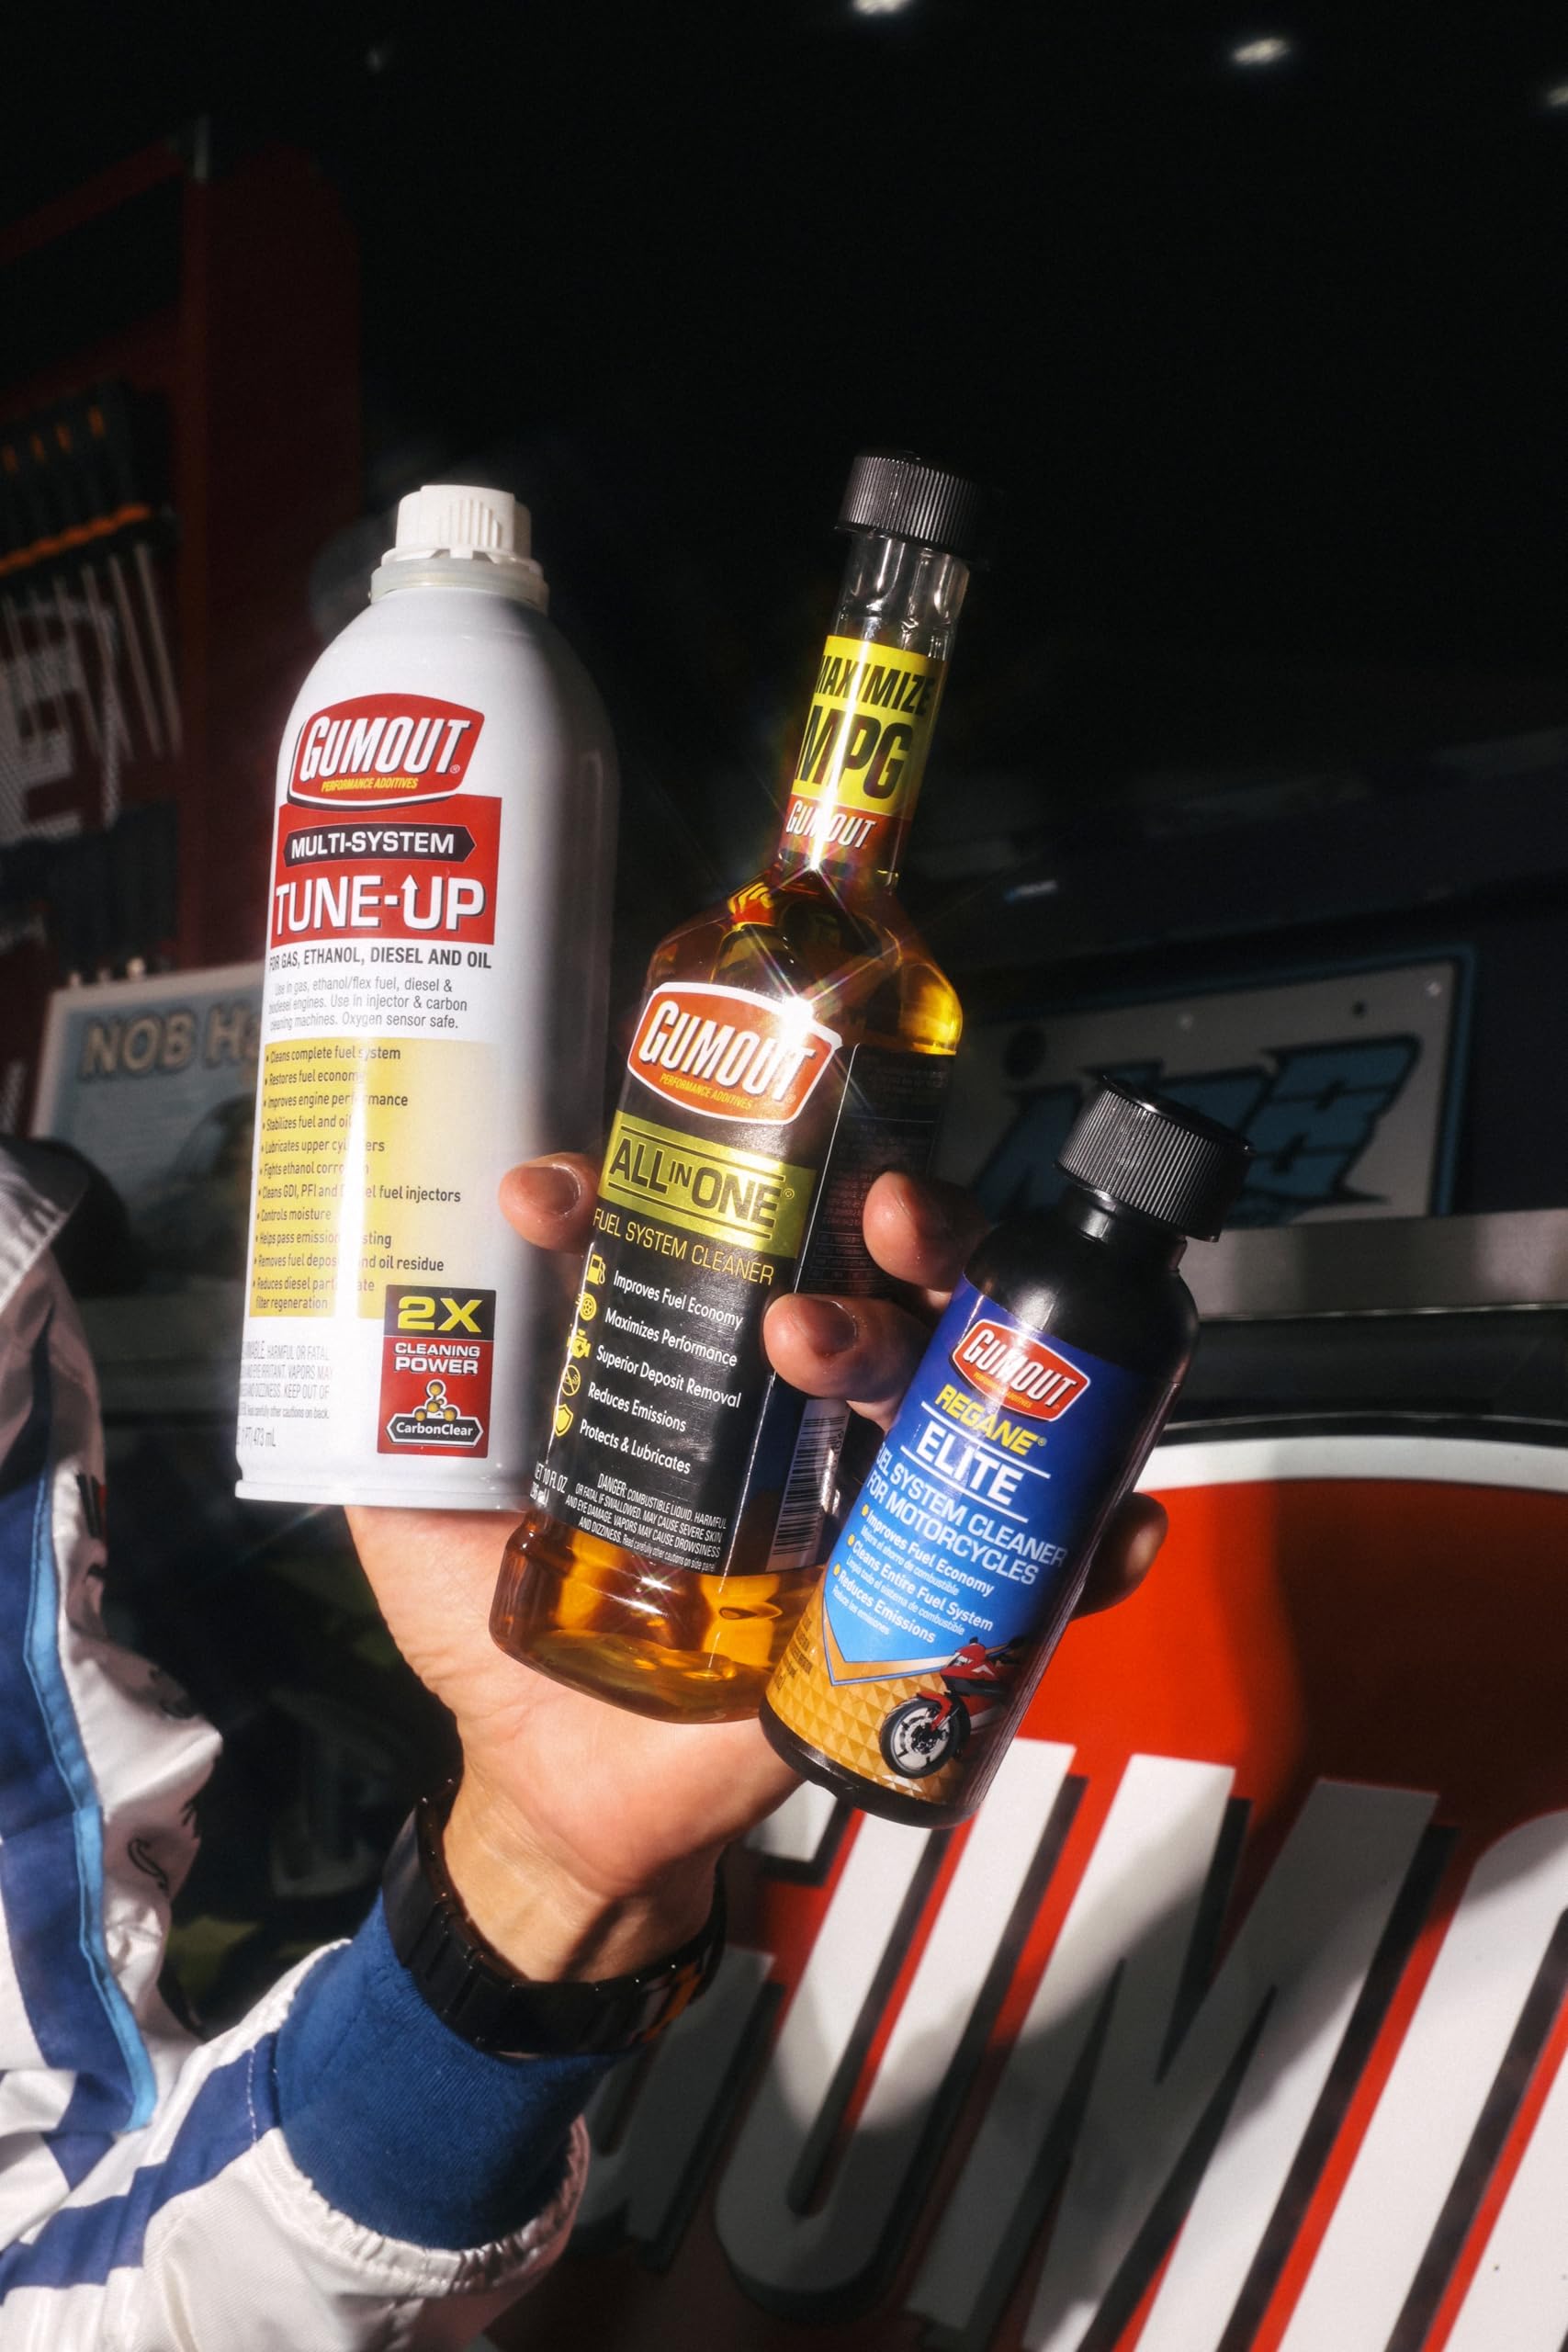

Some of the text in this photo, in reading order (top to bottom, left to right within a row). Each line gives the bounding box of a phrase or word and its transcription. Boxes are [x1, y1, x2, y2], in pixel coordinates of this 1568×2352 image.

[299, 716, 470, 781] GUMOUT
[321, 777, 419, 792] PERFORMANCE ADDITIVES
[291, 831, 454, 860] MULTI-SYSTEM
[276, 875, 485, 935] TUNE-UP
[269, 946, 492, 971] FOR GAS, ETHANOL, DIESEL AND OIL
[312, 976, 371, 990] ethanol/flex
[375, 977, 400, 993] fuel,
[404, 977, 439, 990] diesel
[444, 979, 453, 992] &
[331, 994, 349, 1007] Use
[353, 994, 362, 1007] in
[367, 994, 410, 1011] injector
[413, 996, 422, 1009] &
[426, 997, 468, 1011] carbon
[342, 1012, 382, 1028] Oxygen
[387, 1013, 425, 1026] sensor
[430, 1015, 458, 1029] safe.
[82, 1012, 195, 1080] NOB
[270, 1051, 290, 1063] Cleans
[291, 1046, 332, 1062] complete
[334, 1046, 355, 1059] fuel
[638, 1000, 816, 1102] GUMOUT
[269, 1069, 364, 1086] Restores fuel econom
[660, 1072, 754, 1111] PERFORMANCE ADDITIVES
[299, 1091, 329, 1108] engine
[331, 1092, 408, 1108] permance
[266, 1116, 297, 1131] Stabilizes
[299, 1114, 316, 1128] fuel
[318, 1115, 336, 1128] and
[265, 1139, 385, 1154] Lubricates upper cylers
[283, 1161, 314, 1175] ethanol
[609, 1137, 669, 1193] ALL
[668, 1161, 690, 1188] IN
[692, 1167, 783, 1228] ONE
[263, 1186, 281, 1199] Cleans
[283, 1185, 299, 1199] GDI,
[301, 1183, 316, 1197] PFI
[319, 1184, 338, 1197] and
[379, 1186, 403, 1201] fuel
[406, 1187, 461, 1204] injectors
[261, 1207, 331, 1222] Controls moisture
[277, 1233, 294, 1246] pass
[297, 1230, 341, 1243] emission
[362, 1231, 391, 1247] sting
[593, 1207, 622, 1238] FUEL
[626, 1223, 688, 1261] SYSTEM
[692, 1244, 774, 1286] CLEANER
[288, 1253, 304, 1266] fuel
[307, 1254, 337, 1269] depos
[379, 1257, 393, 1270] oil
[397, 1258, 444, 1272] residue
[285, 1276, 310, 1290] diesel
[313, 1278, 375, 1293] partate
[614, 1270, 744, 1331] Improves Fuel Economy
[271, 1296, 328, 1312] regeneration
[397, 1295, 482, 1333] 2X
[394, 1342, 480, 1358] CLEANING
[604, 1307, 738, 1367] Maximizes Performance
[394, 1357, 479, 1375] POWER
[596, 1344, 742, 1408] Superior Deposit Removal
[964, 1328, 1077, 1408] GUMOUT
[588, 1381, 686, 1432] Reduces Emissions
[935, 1384, 1042, 1457] REGANE
[396, 1421, 474, 1437] CarbonClear
[580, 1419, 691, 1475] Protects & Lubricates
[535, 1461, 544, 1481] ET
[557, 1475, 568, 1493] OZ
[915, 1420, 1024, 1506] ELITE
[575, 1483, 723, 1543] OR FATAL IF SWALLOWED. MAY CAUSE SEVERE SKIN
[597, 1473, 727, 1530] DANGER: COMBUSTIBLE LIQUID. HARMFUL
[892, 1461, 964, 1527] SYSTEM
[967, 1512, 1068, 1568] CLEANER
[565, 1494, 578, 1509] AND
[577, 1499, 588, 1513] EYE
[587, 1502, 613, 1524] DAMAGE.
[614, 1515, 637, 1534] VAPORS
[637, 1524, 651, 1538] MAY
[652, 1530, 675, 1546] CAUSE
[674, 1536, 720, 1558] DROWSINESS
[578, 1516, 592, 1531] AND
[592, 1522, 622, 1544] DIZZINESS.
[623, 1534, 634, 1548] Read
[691, 1558, 702, 1569] side
[867, 1470, 887, 1504] FOR
[886, 1494, 1039, 1586] MOTORCYCLES
[866, 1510, 908, 1551] Improves
[908, 1542, 937, 1567] Fuel
[935, 1557, 995, 1597] Economy
[852, 1541, 881, 1571] Cleans
[880, 1563, 917, 1594] Entire
[917, 1587, 947, 1611] Fuel
[946, 1601, 994, 1632] System
[838, 1570, 874, 1607] Reduces
[874, 1598, 936, 1644] Emissions
[918, 1608, 965, 1636] combustible
